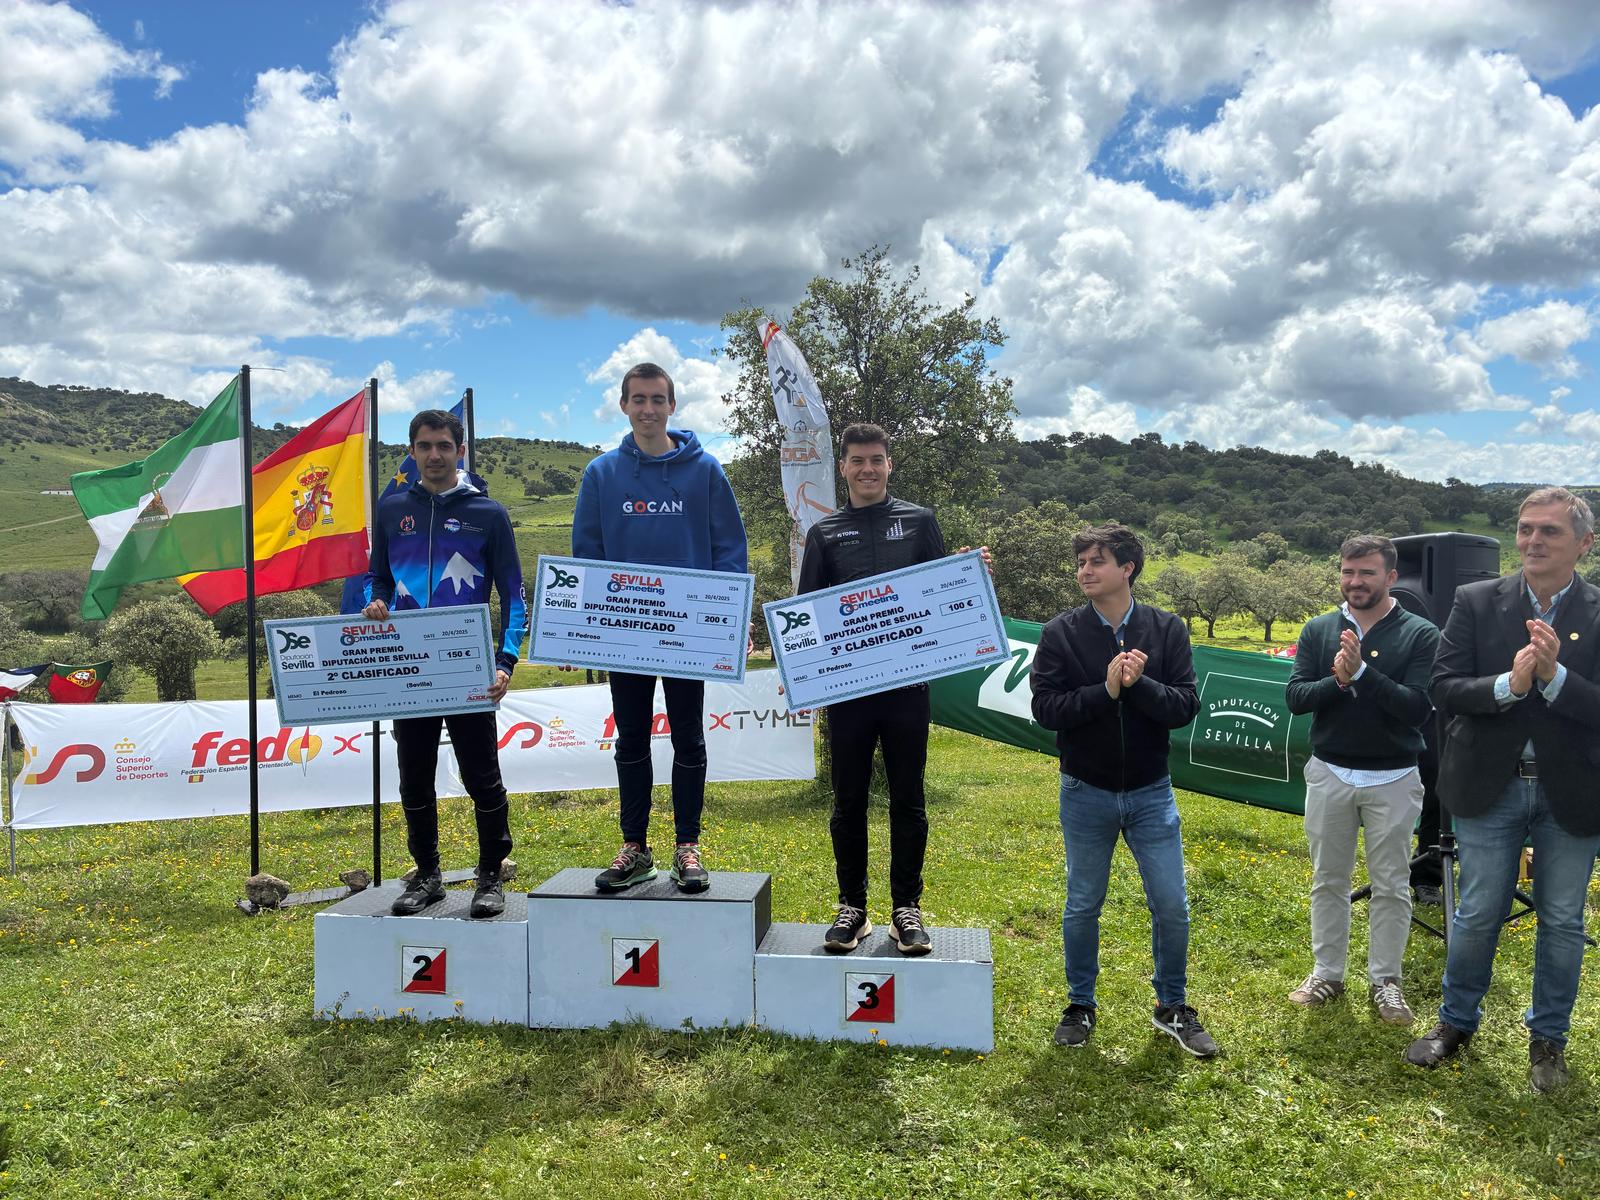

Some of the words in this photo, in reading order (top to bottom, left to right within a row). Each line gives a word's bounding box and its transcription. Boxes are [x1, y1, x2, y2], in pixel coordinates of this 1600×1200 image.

[622, 500, 683, 513] GOCAN
[611, 574, 662, 588] SEVILLA
[546, 591, 578, 599] Diputación
[606, 596, 630, 604] GRAN
[632, 598, 666, 608] PREMIO
[840, 584, 894, 606] SEVILLA
[545, 598, 576, 608] Sevilla
[948, 602, 964, 612] 100
[584, 602, 637, 614] DIPUTACIÓN
[638, 608, 650, 616] DE
[652, 610, 688, 620] SEVILLA
[843, 615, 868, 627] GRAN
[870, 606, 904, 621] PREMIO
[342, 624, 396, 636] SEVILLA
[600, 617, 676, 632] CLASIFICADO
[824, 624, 878, 642] DIPUTACIÓN
[880, 620, 892, 628] DE
[894, 609, 932, 625] SEVILLA
[576, 632, 600, 640] Pedroso
[658, 640, 684, 648] (Sevilla)
[782, 630, 815, 642] Diputación
[845, 625, 923, 652] CLASIFICADO
[342, 647, 368, 656] GRAN
[370, 645, 404, 655] PREMIO
[784, 638, 817, 652] Sevilla
[282, 660, 314, 670] Sevilla
[322, 656, 376, 667] DIPUTACIÓN
[392, 652, 430, 662] SEVILLA
[794, 674, 808, 682] MEMO
[826, 662, 852, 673] Pedroso
[911, 640, 938, 652] (Sevilla)
[342, 666, 420, 680] CLASIFICADO
[320, 688, 347, 696] Pedroso
[406, 680, 432, 689] (Sevilla)
[1209, 699, 1279, 722] DIPUTACION
[1235, 721, 1246, 729] DE
[558, 740, 586, 748] Deportes
[1205, 728, 1272, 752] SEVILLA
[116, 756, 151, 766] Consejo
[116, 764, 153, 774] Superior
[116, 773, 128, 781] de
[129, 770, 168, 781] Deportes
[180, 765, 218, 776] Federación
[219, 765, 248, 774] Española
[258, 761, 294, 770] Orientación
[625, 947, 641, 974] 1
[412, 955, 433, 982] 2
[857, 981, 879, 1010] 3
